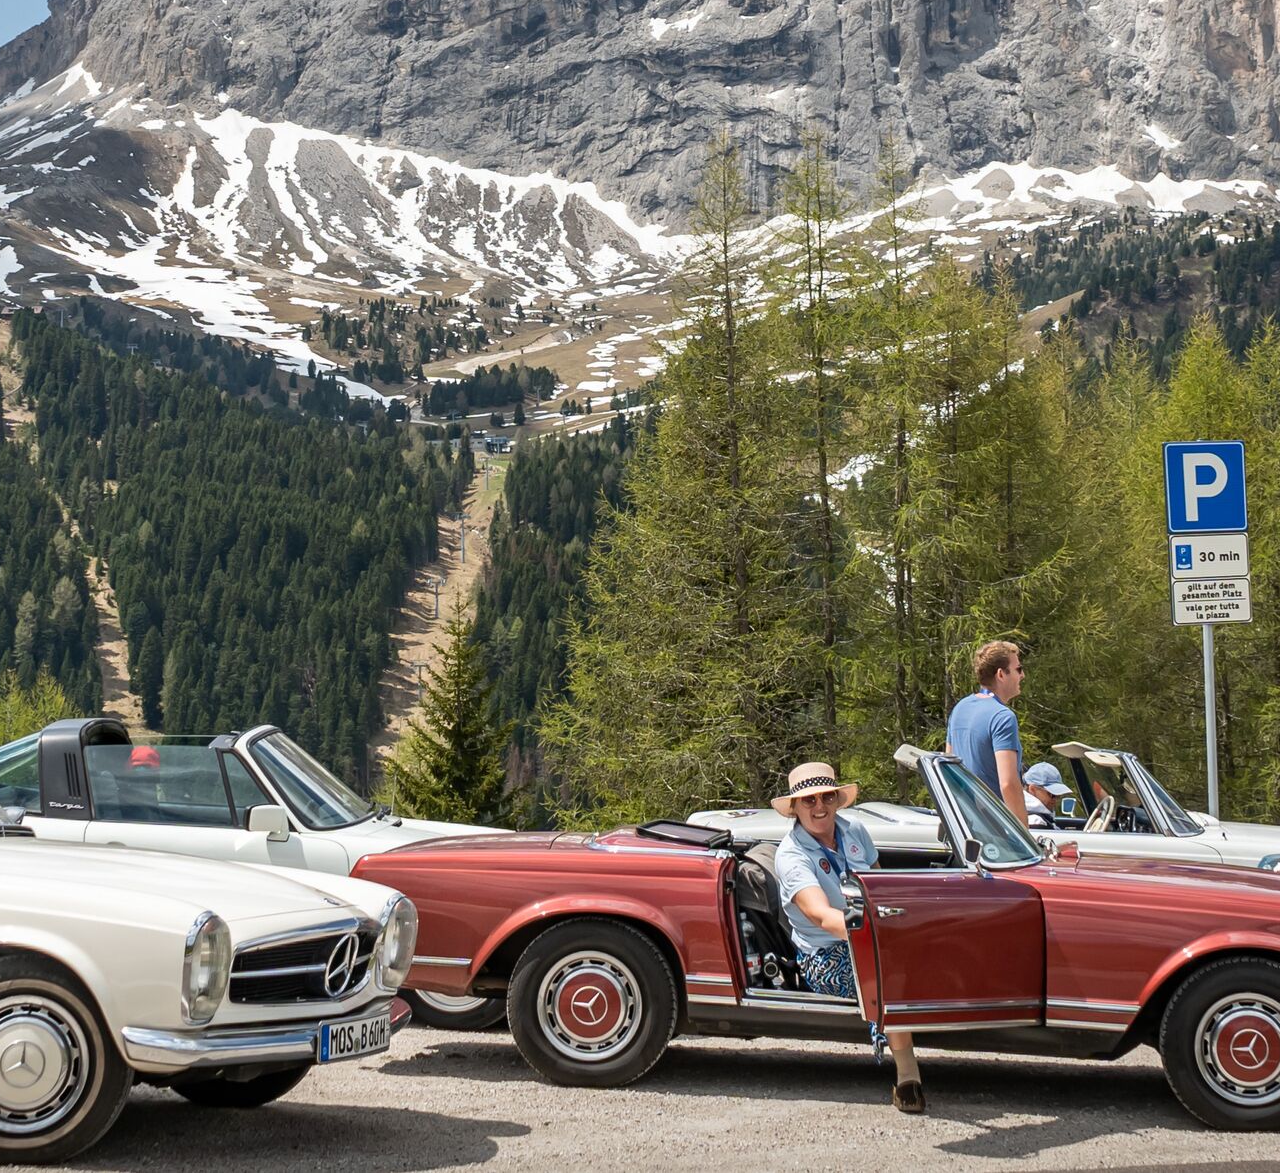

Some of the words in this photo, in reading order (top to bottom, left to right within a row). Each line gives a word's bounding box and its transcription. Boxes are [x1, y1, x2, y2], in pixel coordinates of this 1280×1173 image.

[1182, 452, 1228, 522] P
[1199, 551, 1216, 562] 30
[1219, 550, 1240, 561] min
[1187, 583, 1202, 592] gilt
[1203, 582, 1217, 590] auf
[1181, 592, 1220, 600] gesamten
[1206, 612, 1230, 620] piazza
[330, 1025, 354, 1055] MOS
